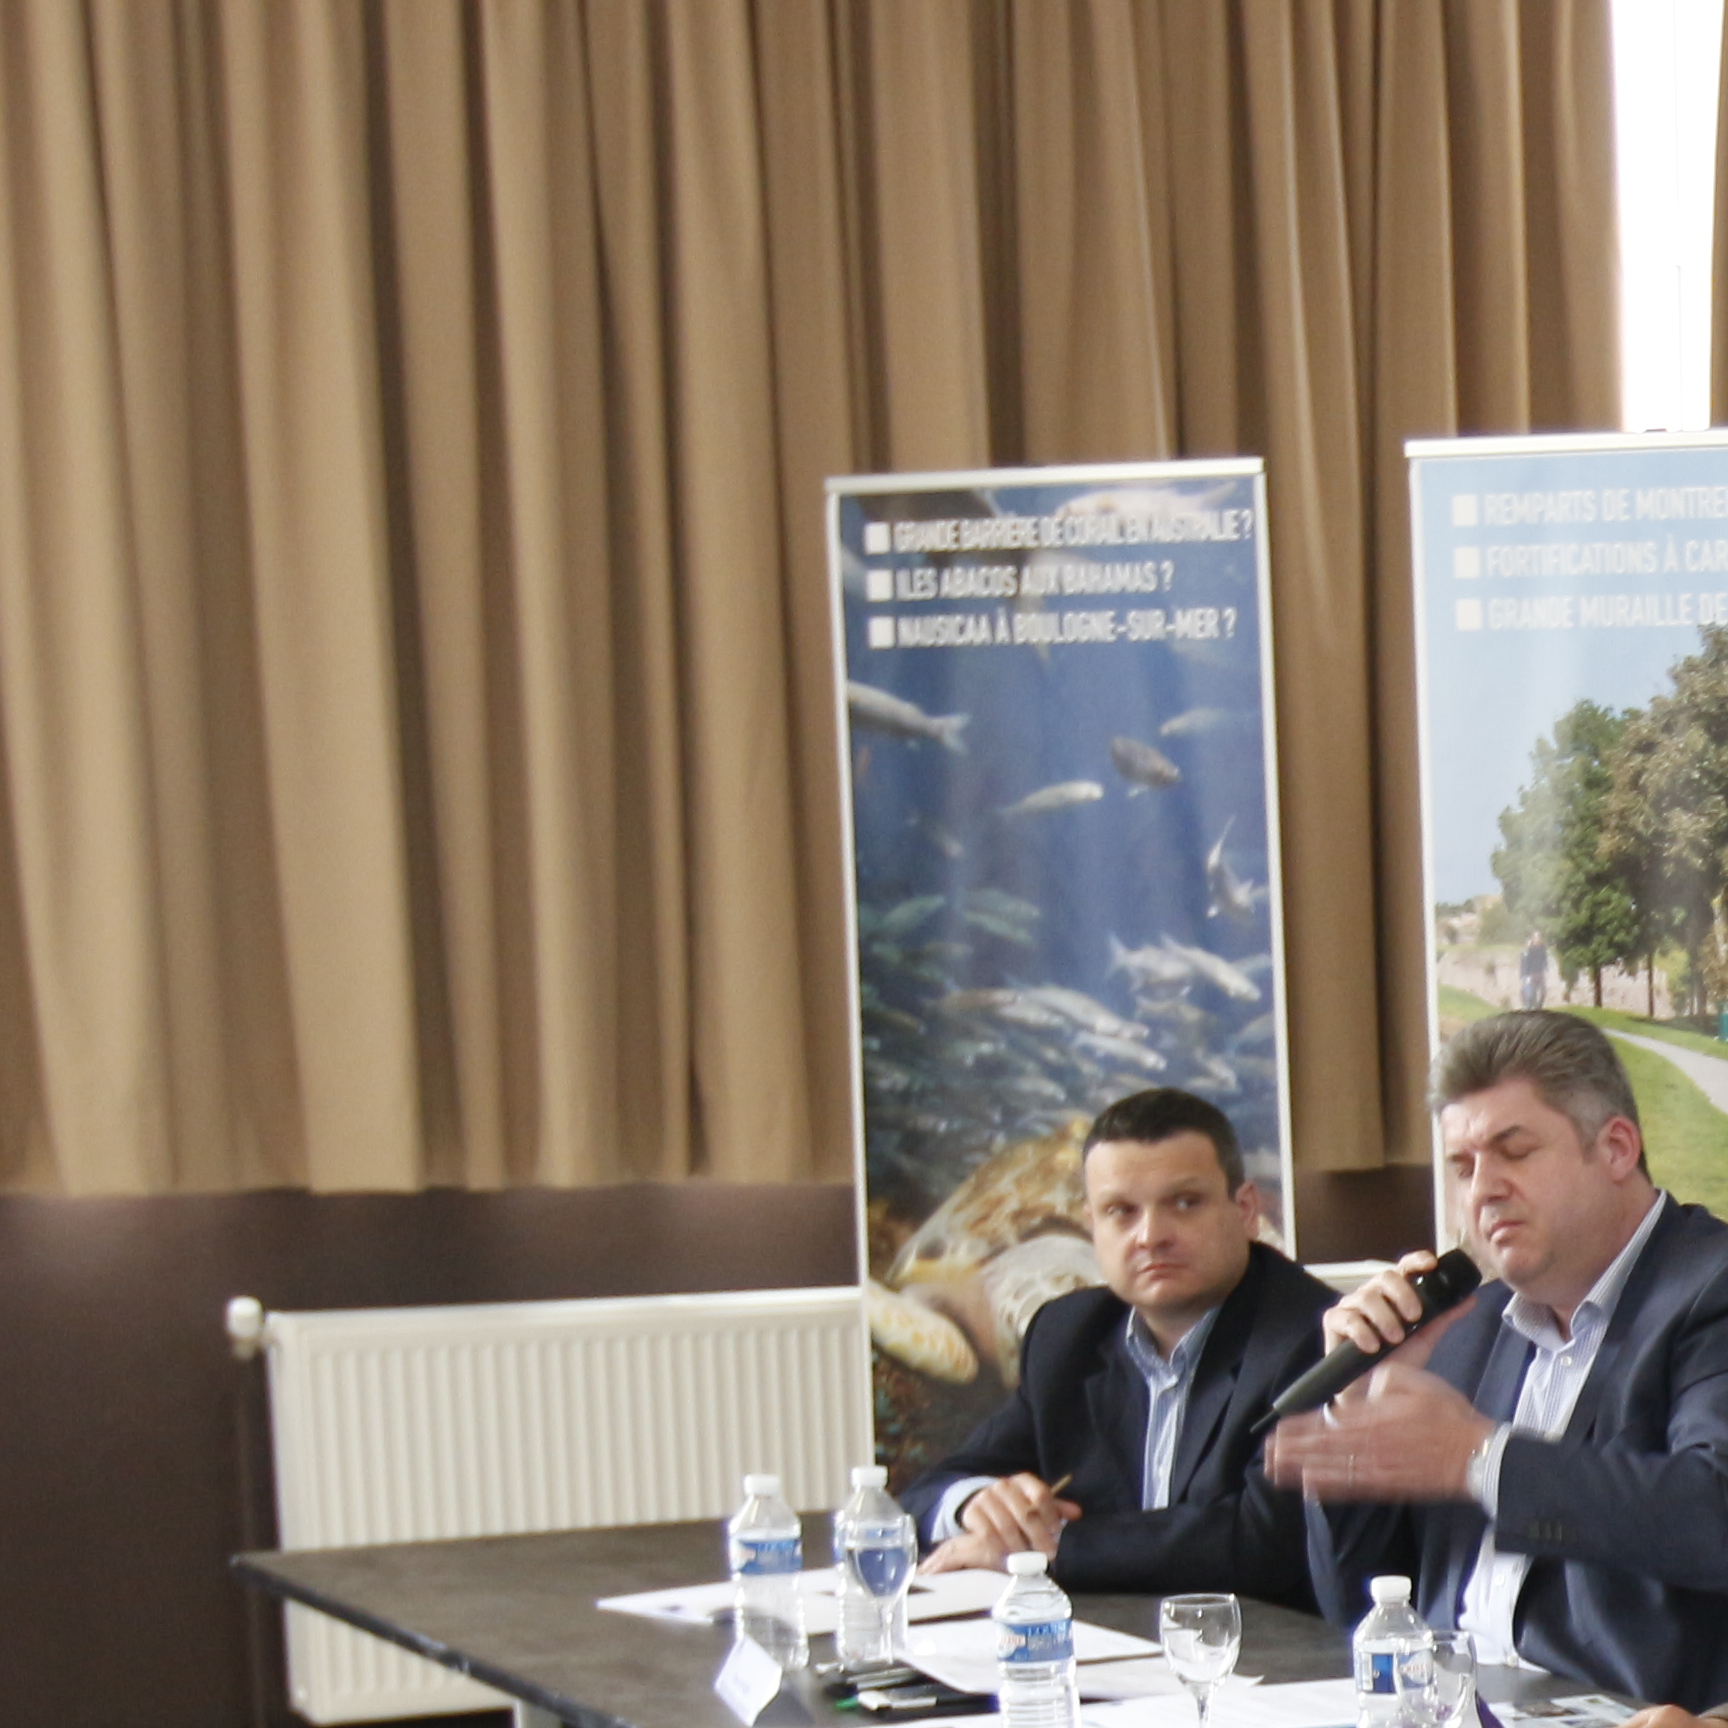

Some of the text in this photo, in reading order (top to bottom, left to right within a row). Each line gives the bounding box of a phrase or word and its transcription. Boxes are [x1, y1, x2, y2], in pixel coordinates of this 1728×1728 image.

[1484, 490, 1597, 525] REMPARTS
[1602, 488, 1631, 522] DE
[1486, 541, 1658, 577] FORTIFICATIONS
[1663, 532, 1679, 573] À
[939, 564, 1019, 600] ABACOS
[1062, 561, 1159, 596] BAHAMAS
[1013, 606, 1221, 646] BOULOGNE-SUR-MER
[1488, 597, 1575, 630] GRANDE
[1579, 592, 1693, 628] MURAILLE
